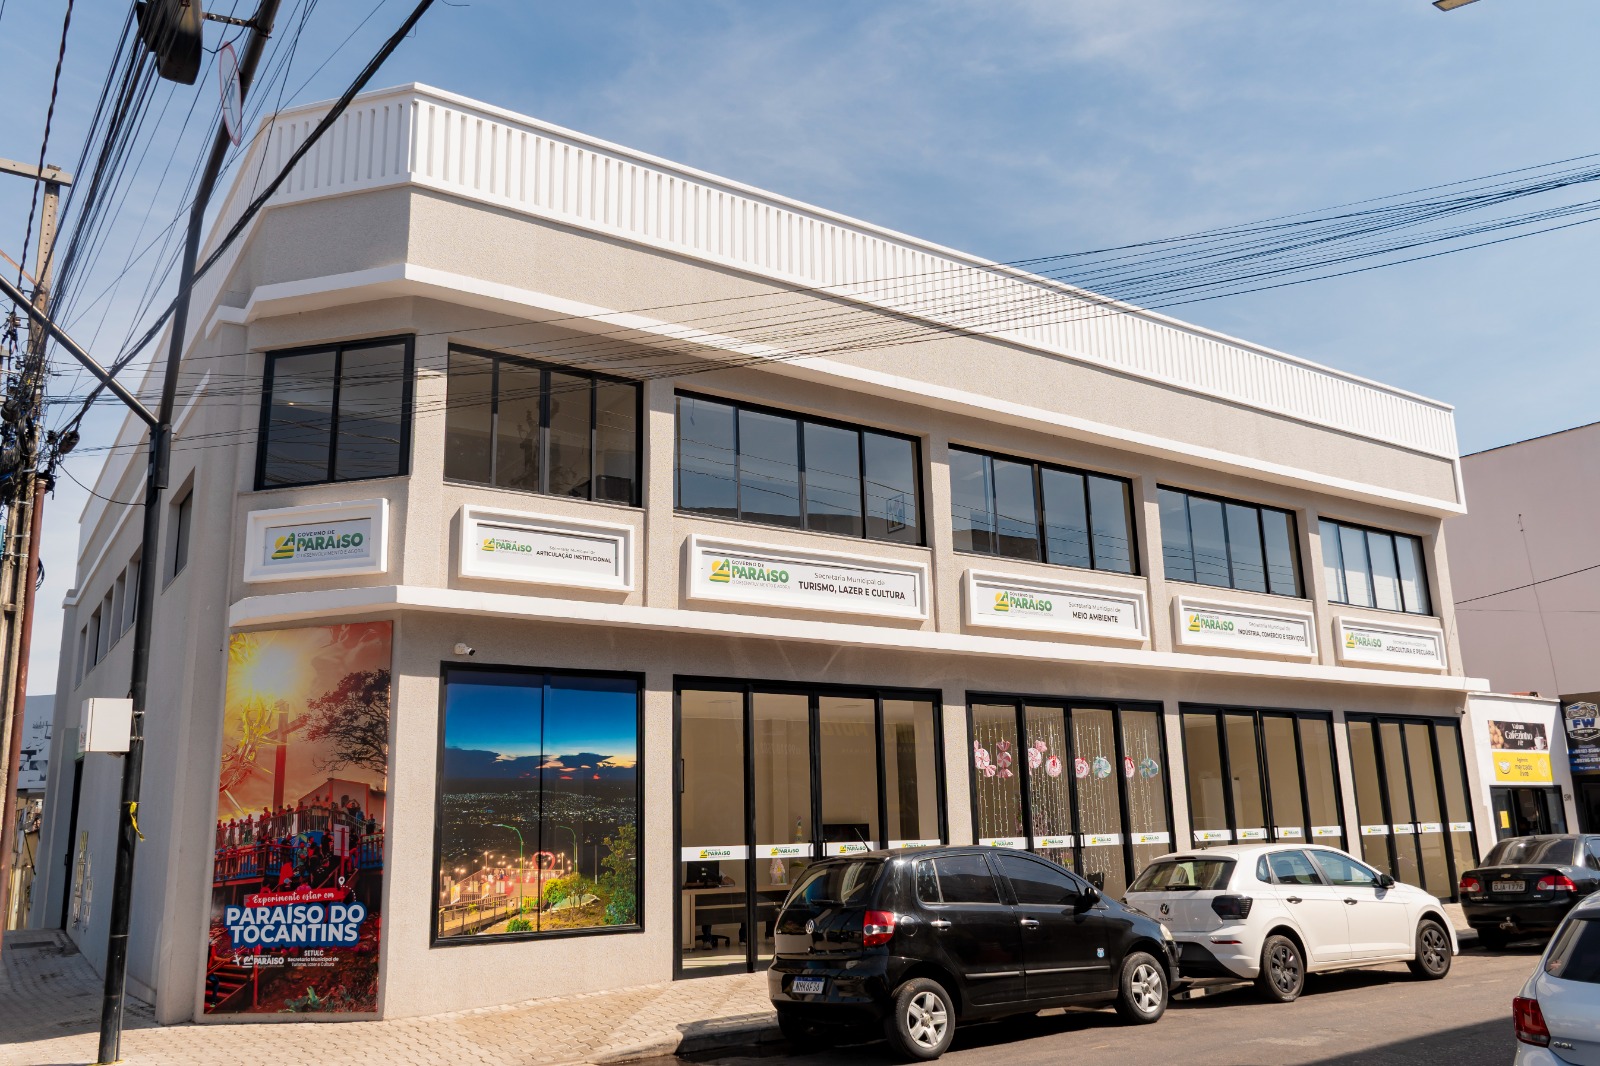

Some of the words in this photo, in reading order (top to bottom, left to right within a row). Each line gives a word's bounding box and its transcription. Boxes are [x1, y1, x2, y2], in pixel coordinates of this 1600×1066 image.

[536, 551, 572, 559] ARTICULAÇÃO
[574, 554, 612, 563] INSTITUCIONAL
[814, 572, 846, 582] Secretaria
[847, 576, 876, 586] Municipal
[798, 581, 837, 594] TURISMO,
[838, 584, 864, 596] LAZER
[865, 588, 870, 596] E
[871, 589, 906, 600] CULTURA
[1072, 611, 1088, 620] MEIO
[1089, 613, 1118, 623] AMBIENTE
[1572, 718, 1595, 728] FW
[252, 893, 300, 905] Experimente
[302, 892, 322, 901] estar
[226, 903, 324, 926] PARAÍSO
[330, 904, 365, 924] DO
[231, 923, 358, 943] TOCANTINS
